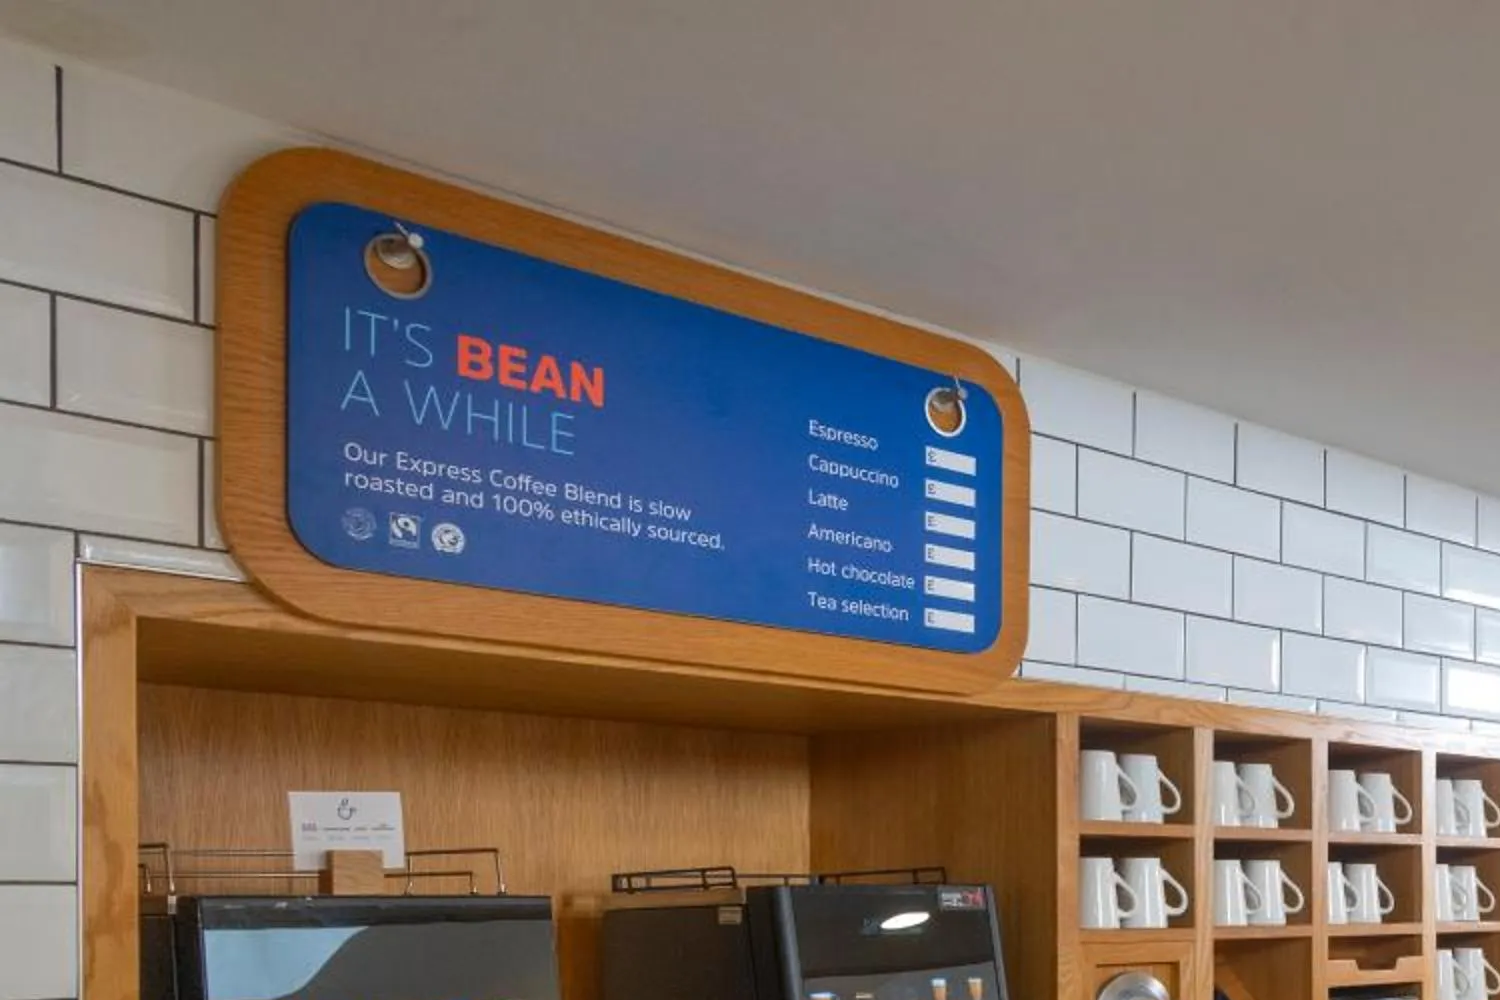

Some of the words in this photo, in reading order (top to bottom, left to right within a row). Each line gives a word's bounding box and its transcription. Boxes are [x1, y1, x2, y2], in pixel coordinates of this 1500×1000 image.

[344, 306, 434, 369] IT'S
[456, 334, 605, 408] BEAN
[341, 370, 380, 417] A
[403, 378, 575, 456] WHILE
[808, 419, 879, 451] Espresso
[344, 442, 389, 467] Our
[396, 451, 483, 484] Express
[489, 469, 557, 497] Coffee
[564, 483, 622, 510] Blend
[628, 495, 643, 513] is
[649, 500, 692, 521] slow
[808, 453, 900, 489] Cappuccino
[344, 471, 434, 500] roasted
[441, 488, 485, 509] and
[491, 493, 555, 521] 100%
[561, 507, 642, 538] ethically
[647, 524, 726, 551] sourced.
[808, 488, 849, 511] Latte
[807, 522, 893, 553] Americano
[807, 557, 837, 577] Hot
[841, 564, 916, 590] chocolate
[807, 591, 838, 611] Tea
[841, 599, 910, 622] selection
